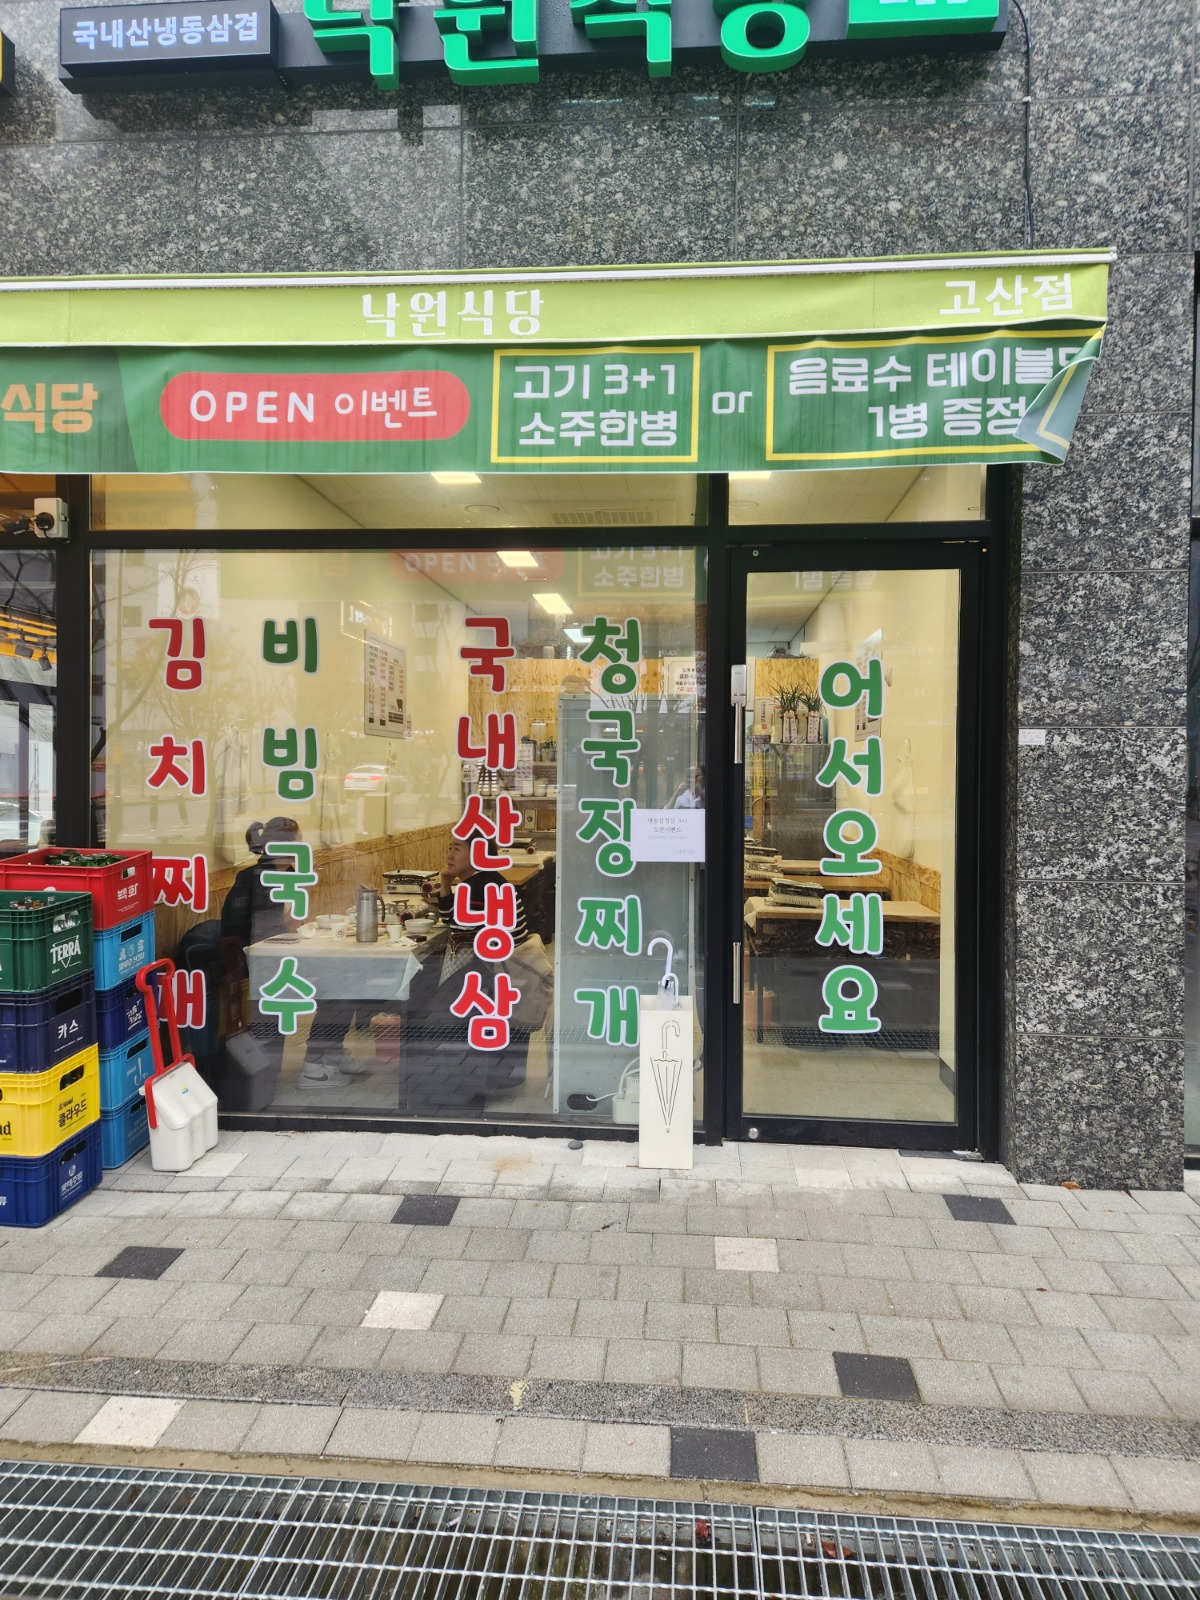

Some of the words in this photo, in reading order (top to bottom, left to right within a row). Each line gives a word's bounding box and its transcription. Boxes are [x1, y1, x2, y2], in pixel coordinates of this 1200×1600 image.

[72, 11, 260, 49] 국내산냉동삼겹
[361, 288, 545, 339] 낙원식당
[939, 273, 1074, 316] 고산점
[513, 364, 590, 399] 고기
[603, 364, 676, 395] 3+1
[788, 357, 912, 394] 음료수
[0, 383, 99, 433] 식당
[189, 390, 315, 424] OPEN
[334, 386, 438, 429] 이벤트
[712, 390, 753, 415] or
[867, 404, 928, 440] 1병
[942, 396, 1027, 436] 증정
[519, 409, 678, 447] 소주한병
[258, 615, 320, 1036] 비빔국수
[814, 657, 885, 1034] 어서오세요
[50, 935, 81, 964] TERRA
[58, 1019, 79, 1039] 카스
[58, 1098, 87, 1128] 클라우드
